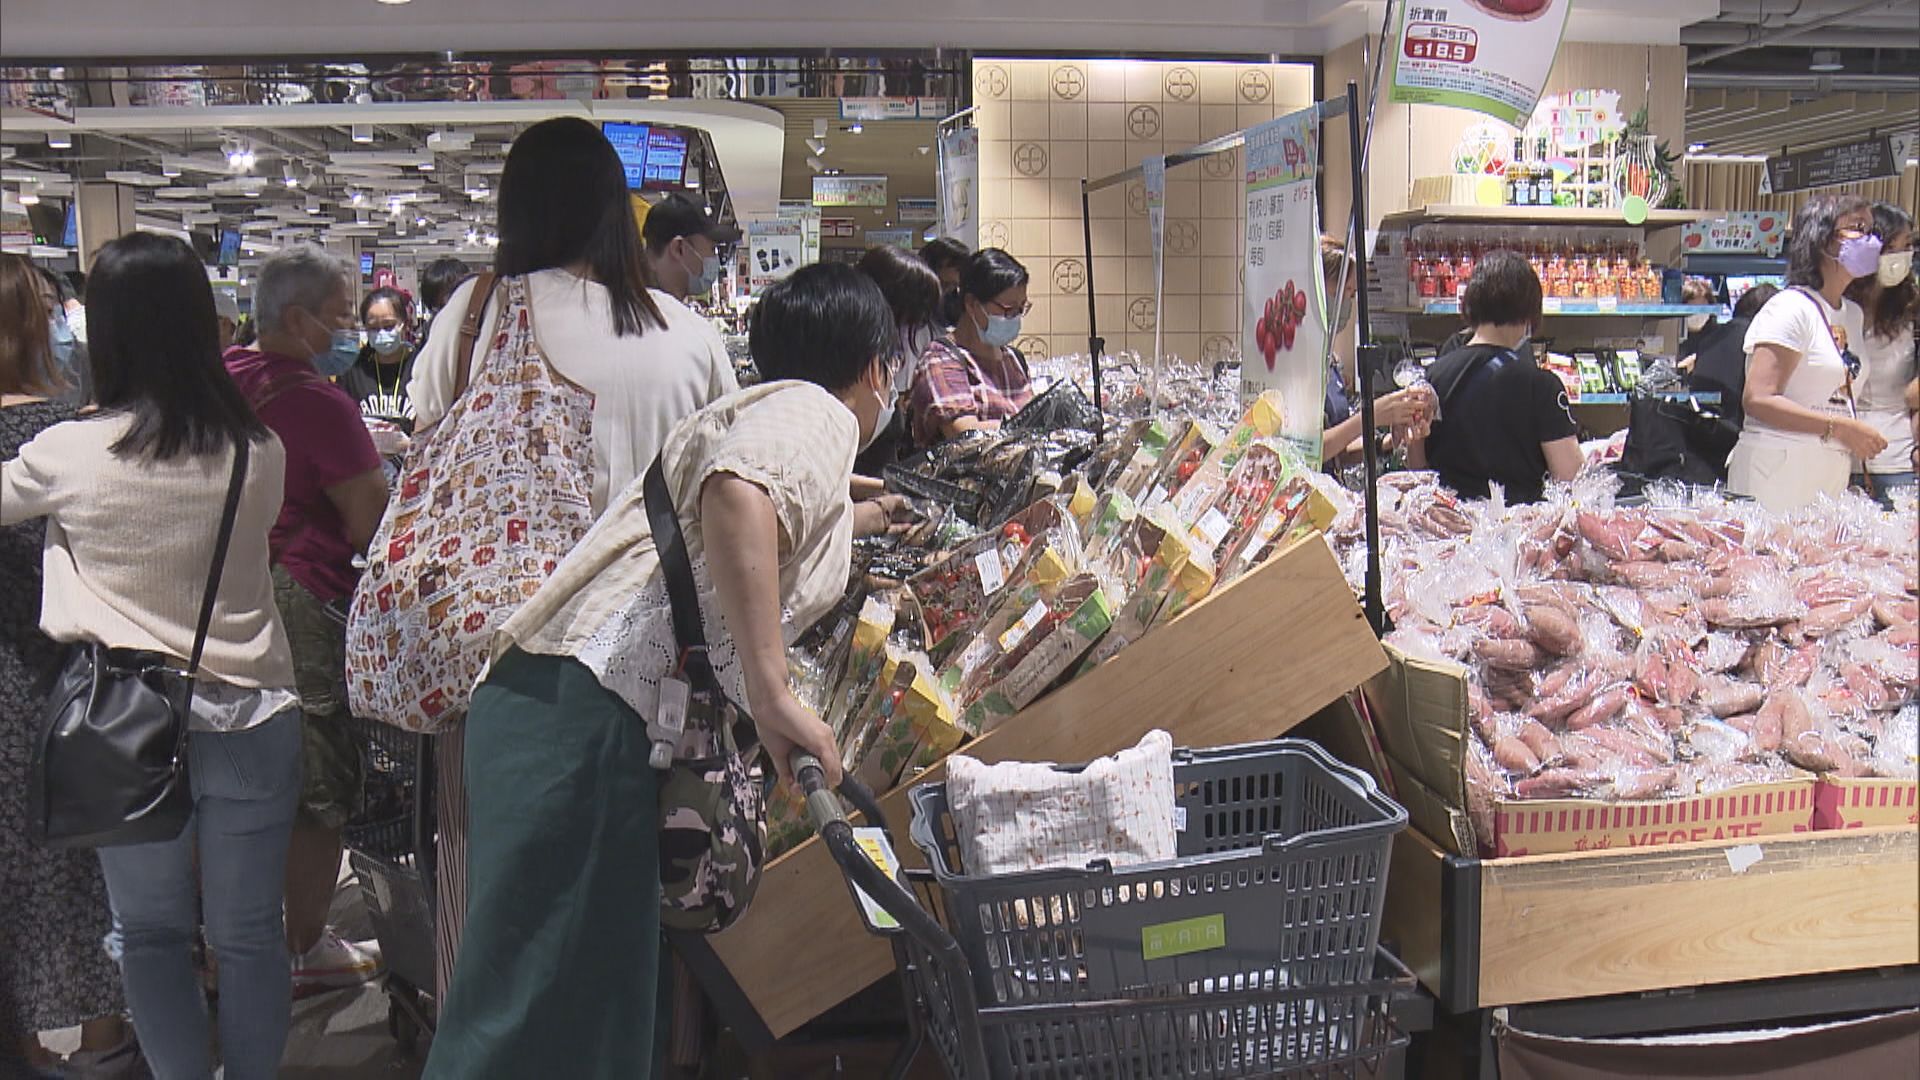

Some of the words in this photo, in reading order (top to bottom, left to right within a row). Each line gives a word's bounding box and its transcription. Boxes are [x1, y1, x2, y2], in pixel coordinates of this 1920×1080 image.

[1409, 6, 1449, 22] 折實價
[1413, 42, 1466, 61] $18.9
